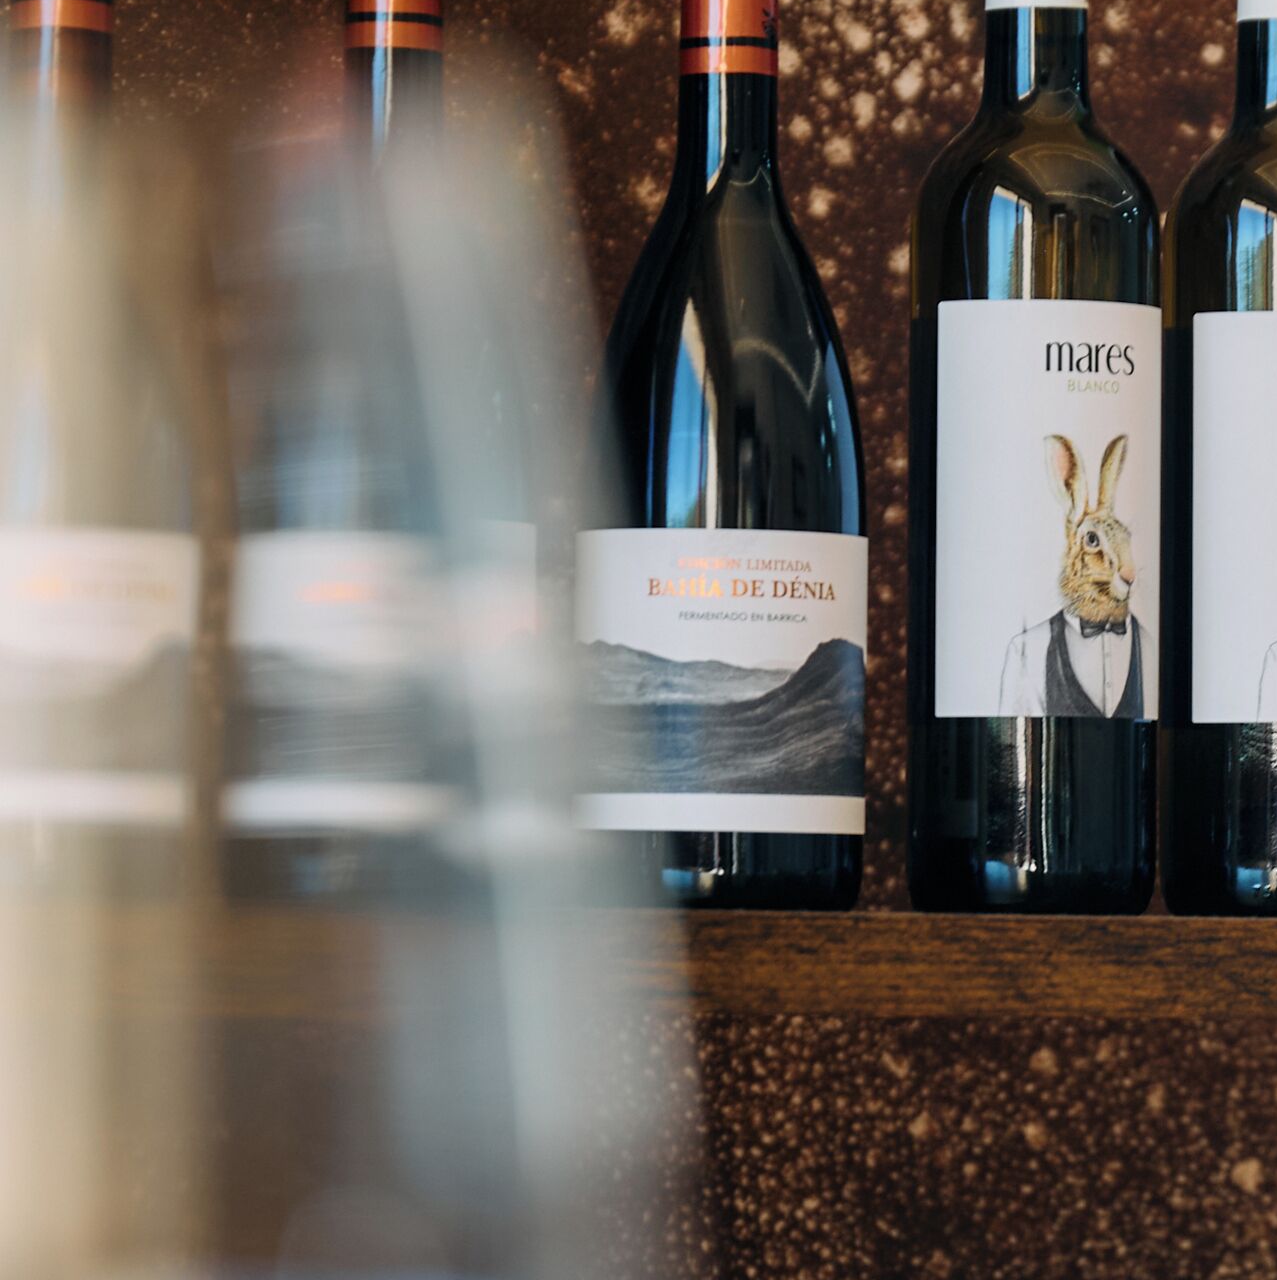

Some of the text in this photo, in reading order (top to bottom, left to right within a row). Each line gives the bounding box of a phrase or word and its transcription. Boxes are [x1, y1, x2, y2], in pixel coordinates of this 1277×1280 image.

[1045, 341, 1135, 376] mares
[1067, 379, 1119, 394] BLANCO
[746, 558, 812, 573] LIMITADA
[732, 578, 764, 598] DE
[772, 576, 836, 601] DÉNIA
[678, 610, 748, 622] FERMENTADO
[751, 612, 764, 622] EN
